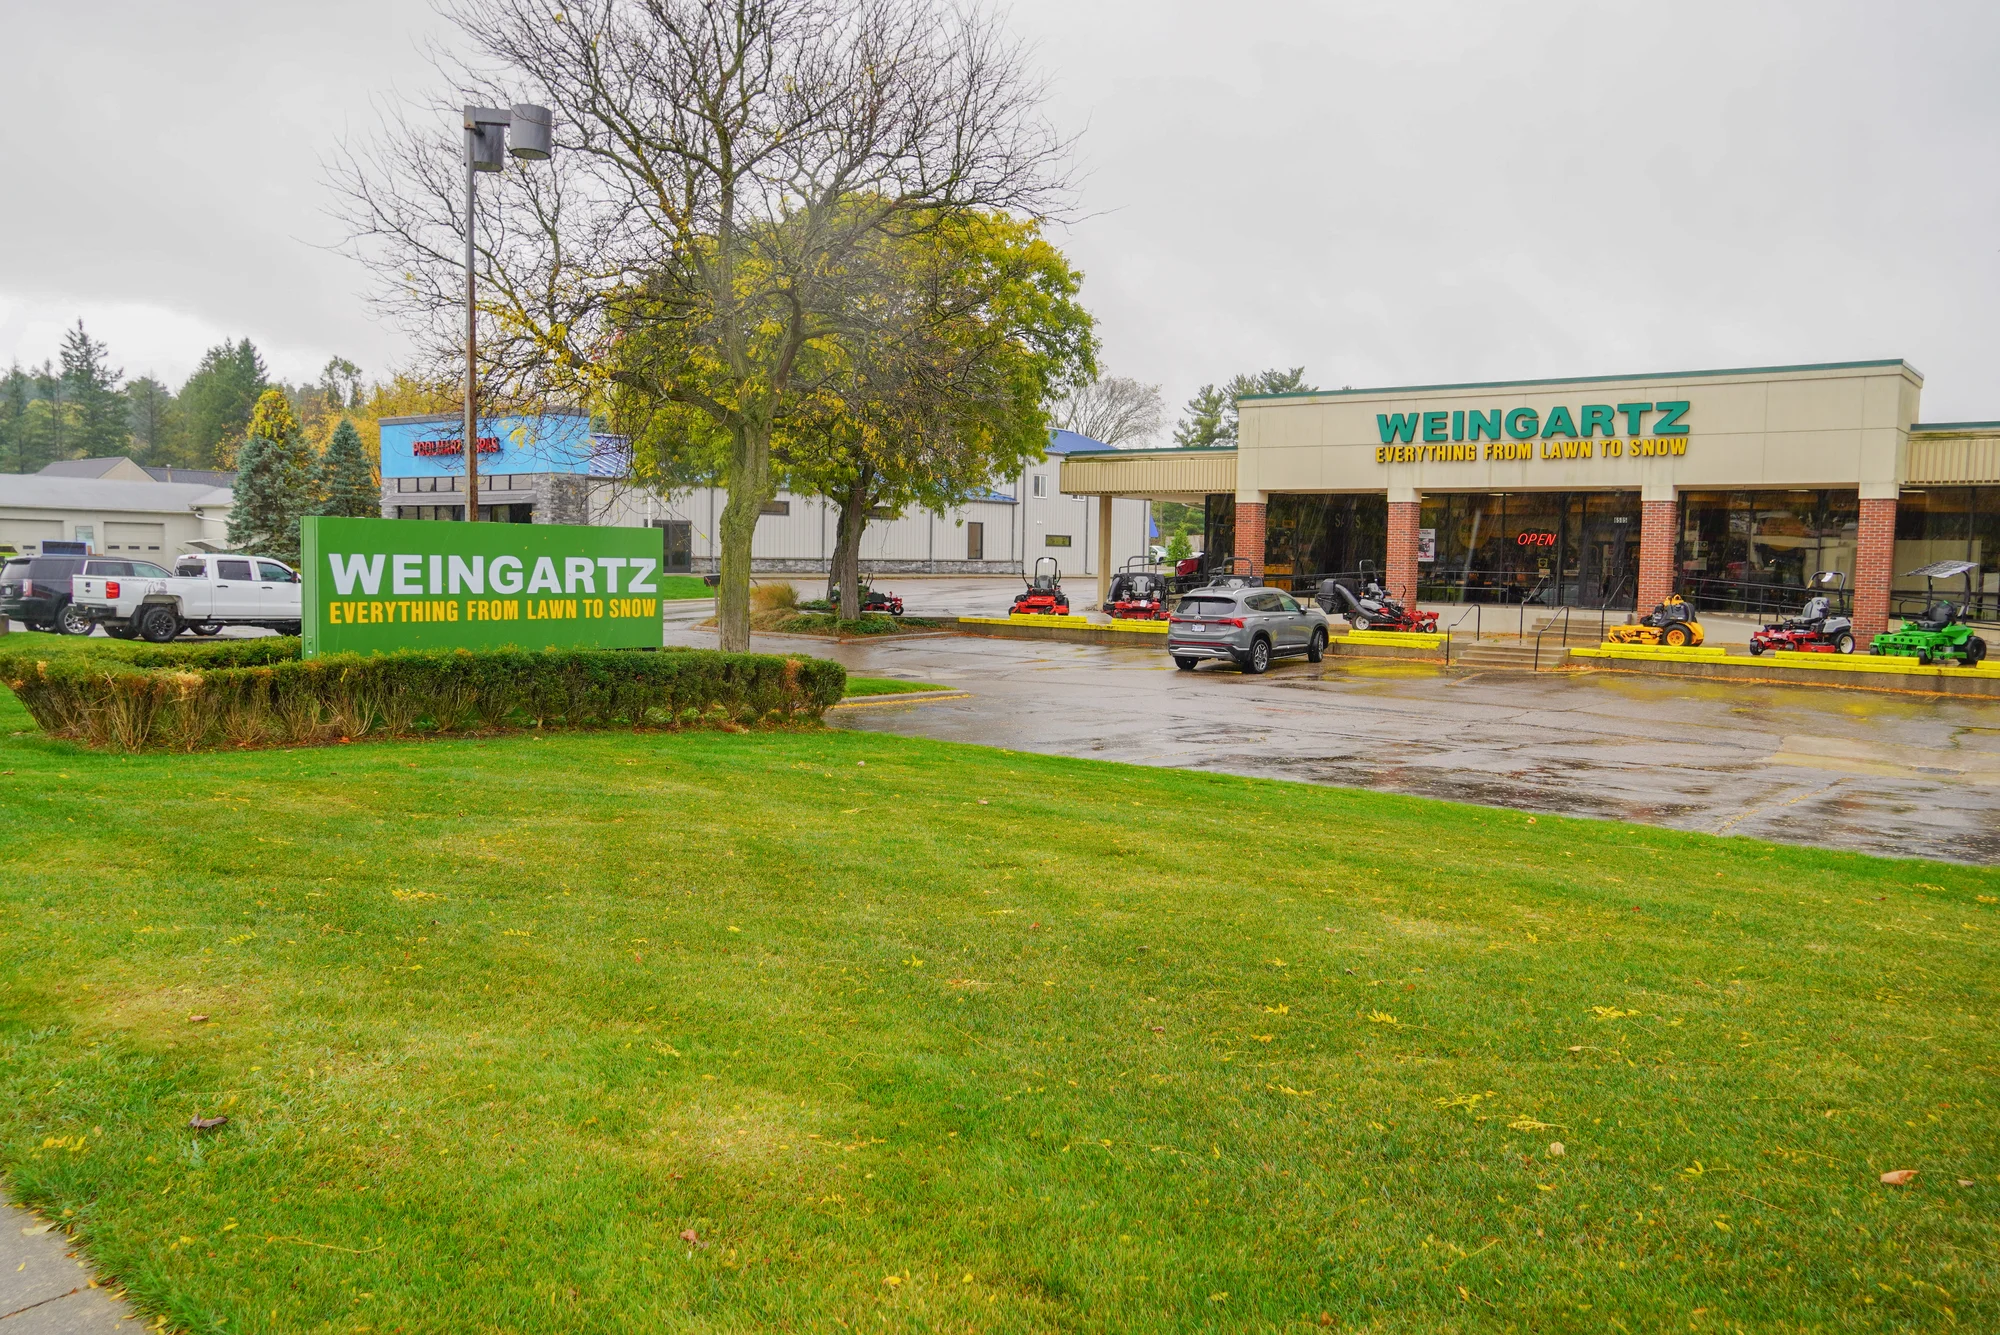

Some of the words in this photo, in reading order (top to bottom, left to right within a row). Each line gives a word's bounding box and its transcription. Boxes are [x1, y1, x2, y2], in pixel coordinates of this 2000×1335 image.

[1376, 400, 1690, 442] WEINGARTZ
[1375, 444, 1476, 463] EVERYTHING
[1484, 443, 1533, 461] FROM
[1541, 441, 1593, 459] LAWN
[1600, 439, 1622, 457] TO
[1629, 438, 1688, 456] SNOW
[1517, 533, 1556, 546] OPEN
[328, 553, 657, 595] WEINGARTZ
[329, 601, 459, 624] EVERYTHING
[467, 600, 519, 621] FROM
[527, 599, 577, 620] LAWN
[583, 599, 604, 619] TO
[609, 598, 656, 618] SNOW
